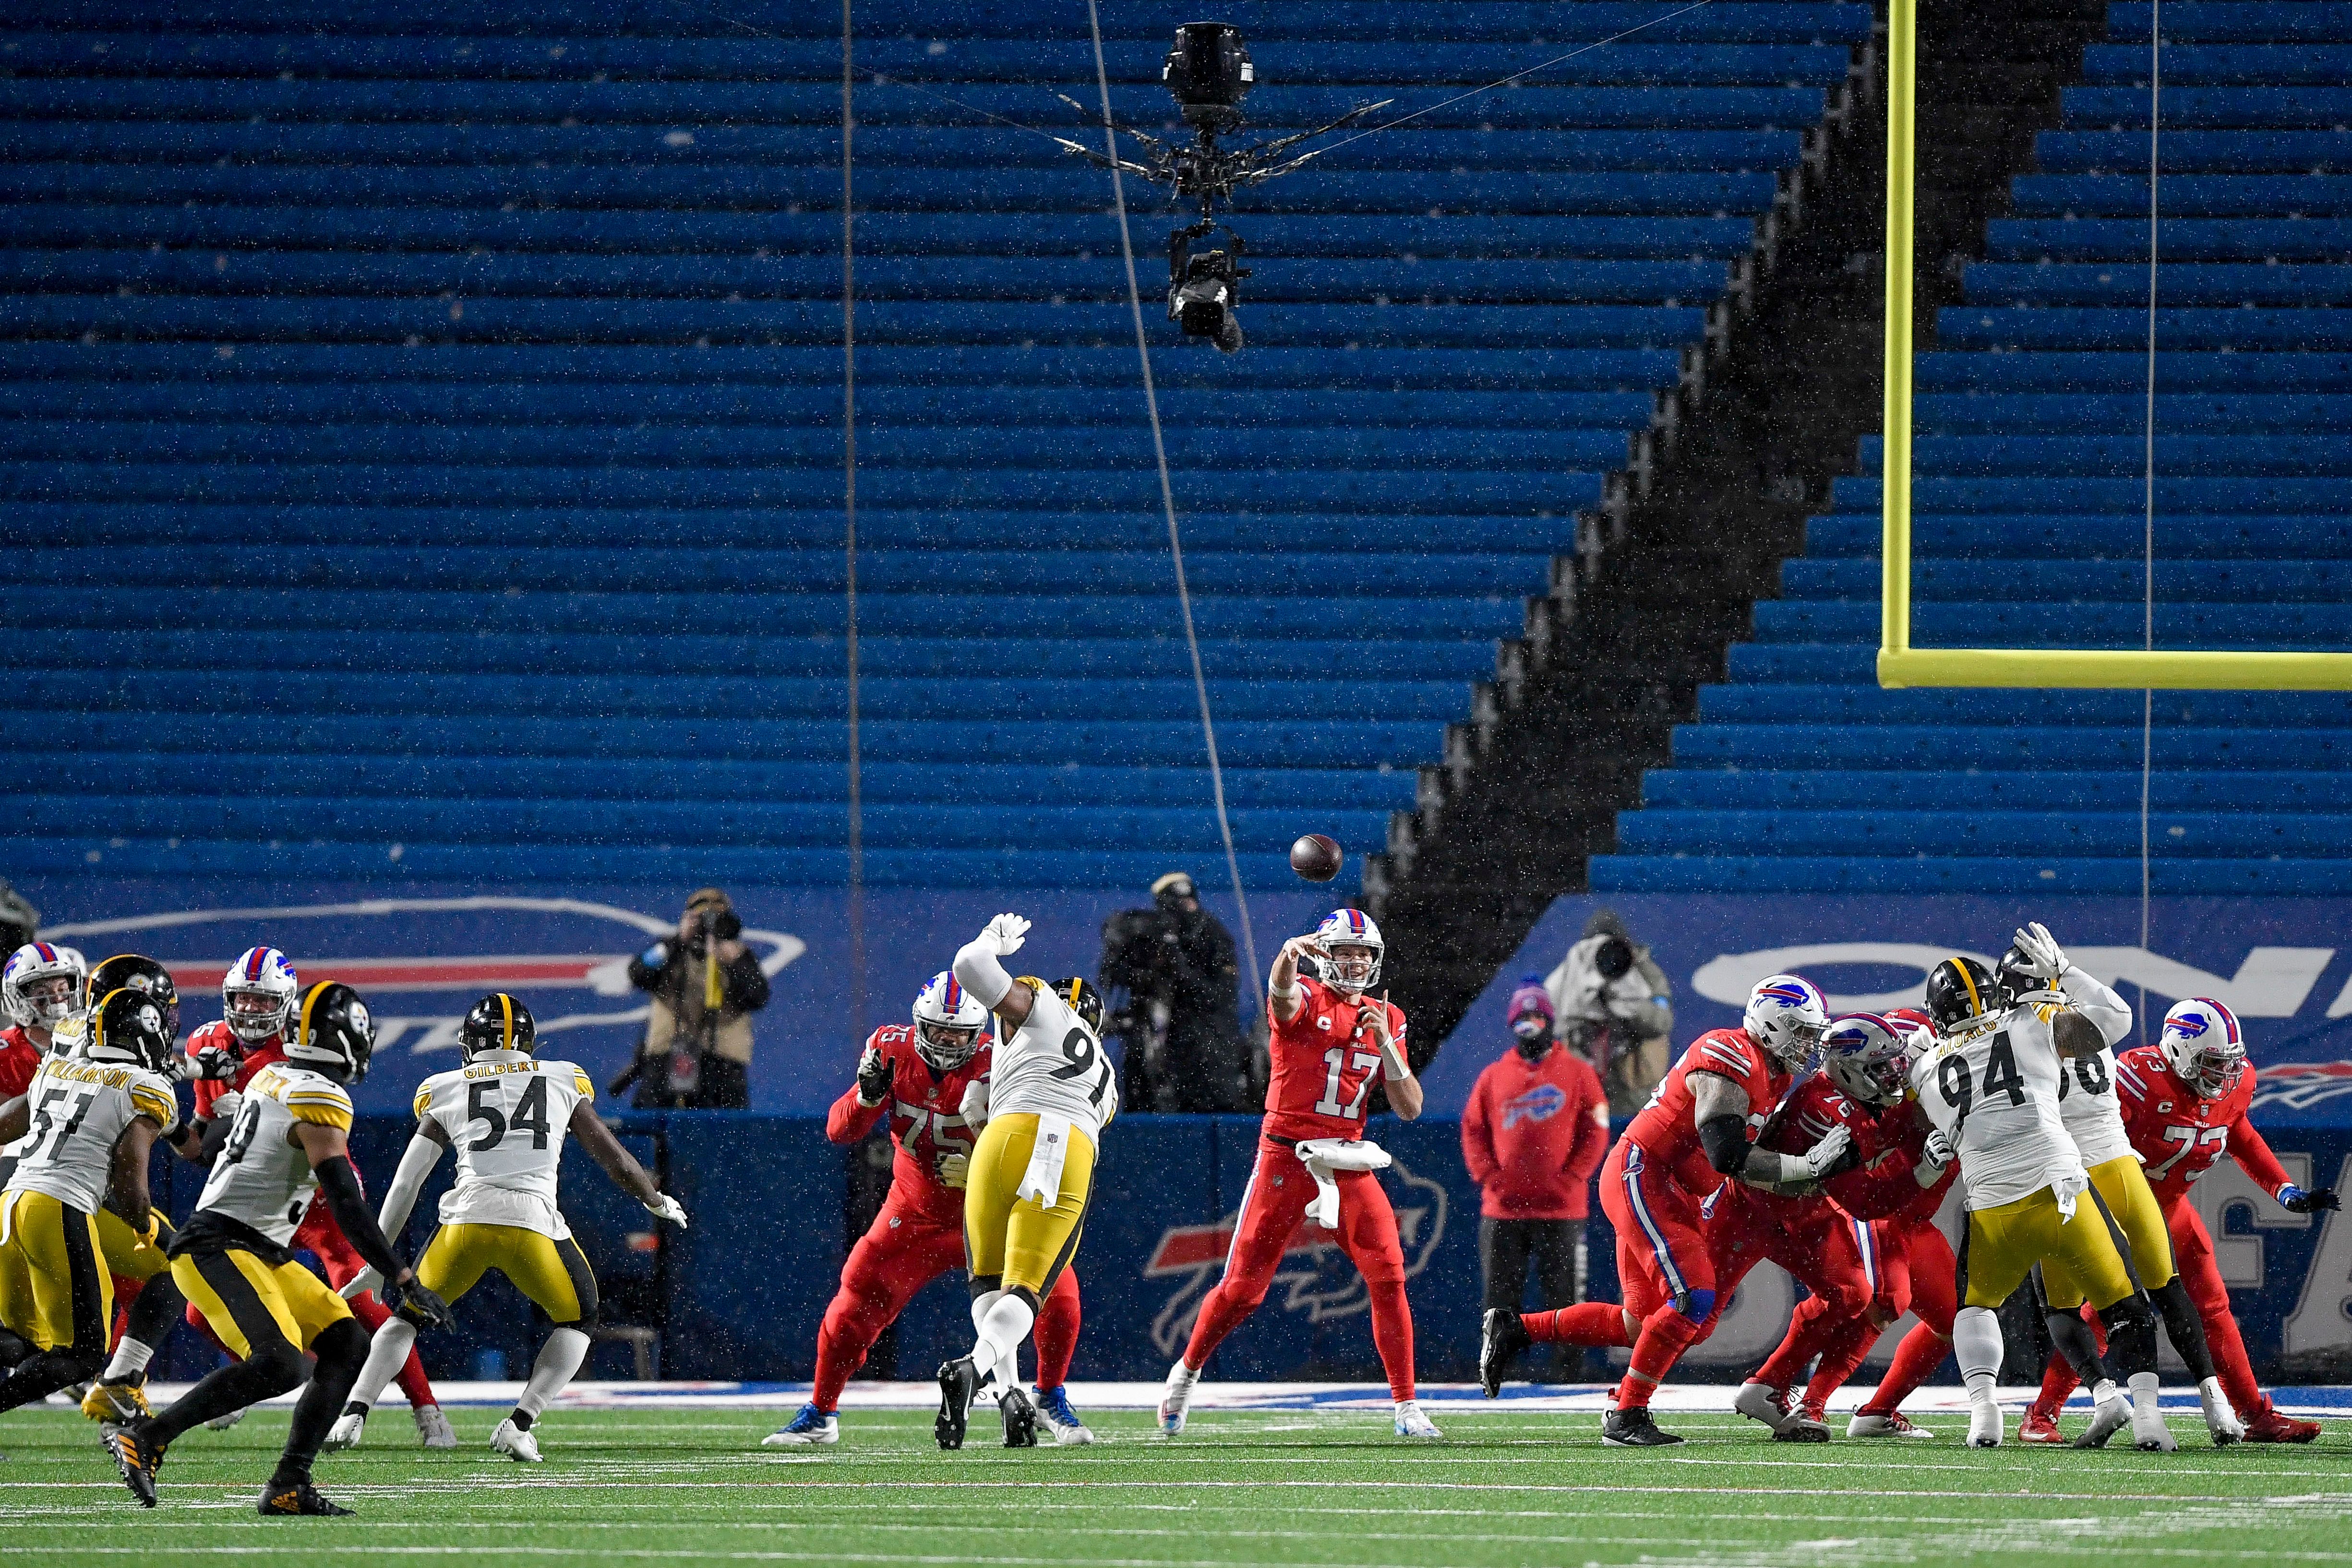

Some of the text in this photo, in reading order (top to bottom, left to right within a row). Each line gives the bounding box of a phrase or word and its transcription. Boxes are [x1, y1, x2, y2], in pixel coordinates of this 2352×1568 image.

[1692, 943, 2352, 1018] ON
[1966, 997, 1988, 1018] 94
[495, 1034, 519, 1051] 54
[1317, 1015, 1332, 1030] C
[464, 1060, 540, 1079] GILBERT
[1315, 1047, 1382, 1120] 17
[1938, 1029, 2025, 1133] 94
[20, 1088, 96, 1160] 51
[467, 1075, 551, 1152] 54
[895, 1099, 972, 1161] 75
[1823, 1089, 1855, 1118] 76
[2157, 1101, 2173, 1113] C
[2144, 1124, 2228, 1182] 73
